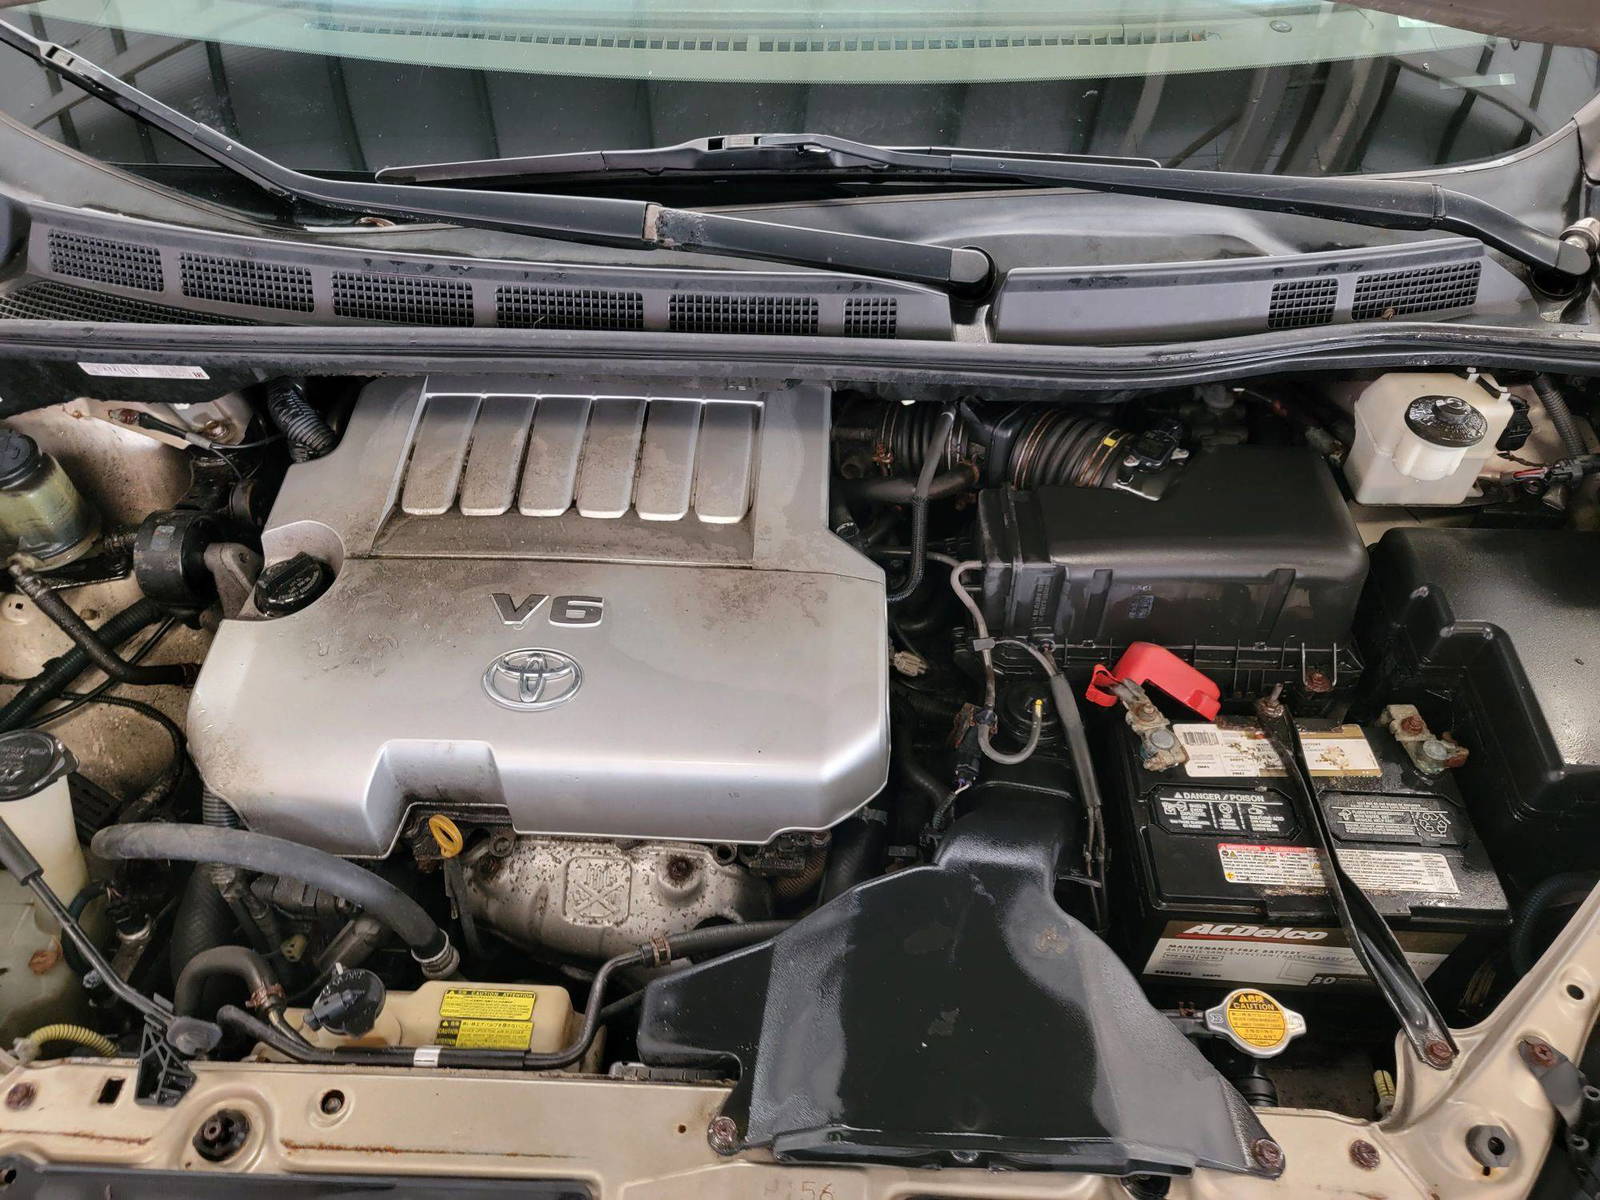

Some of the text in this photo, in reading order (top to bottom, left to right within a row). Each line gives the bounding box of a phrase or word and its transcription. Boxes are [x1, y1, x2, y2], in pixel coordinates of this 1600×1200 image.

[489, 593, 604, 628] V6
[1183, 792, 1221, 801] DANGER
[1230, 794, 1265, 803] POISON
[1183, 923, 1329, 941] ACDelco
[1168, 944, 1234, 952] MAINTENANCE
[1233, 1002, 1275, 1011] CAUTION
